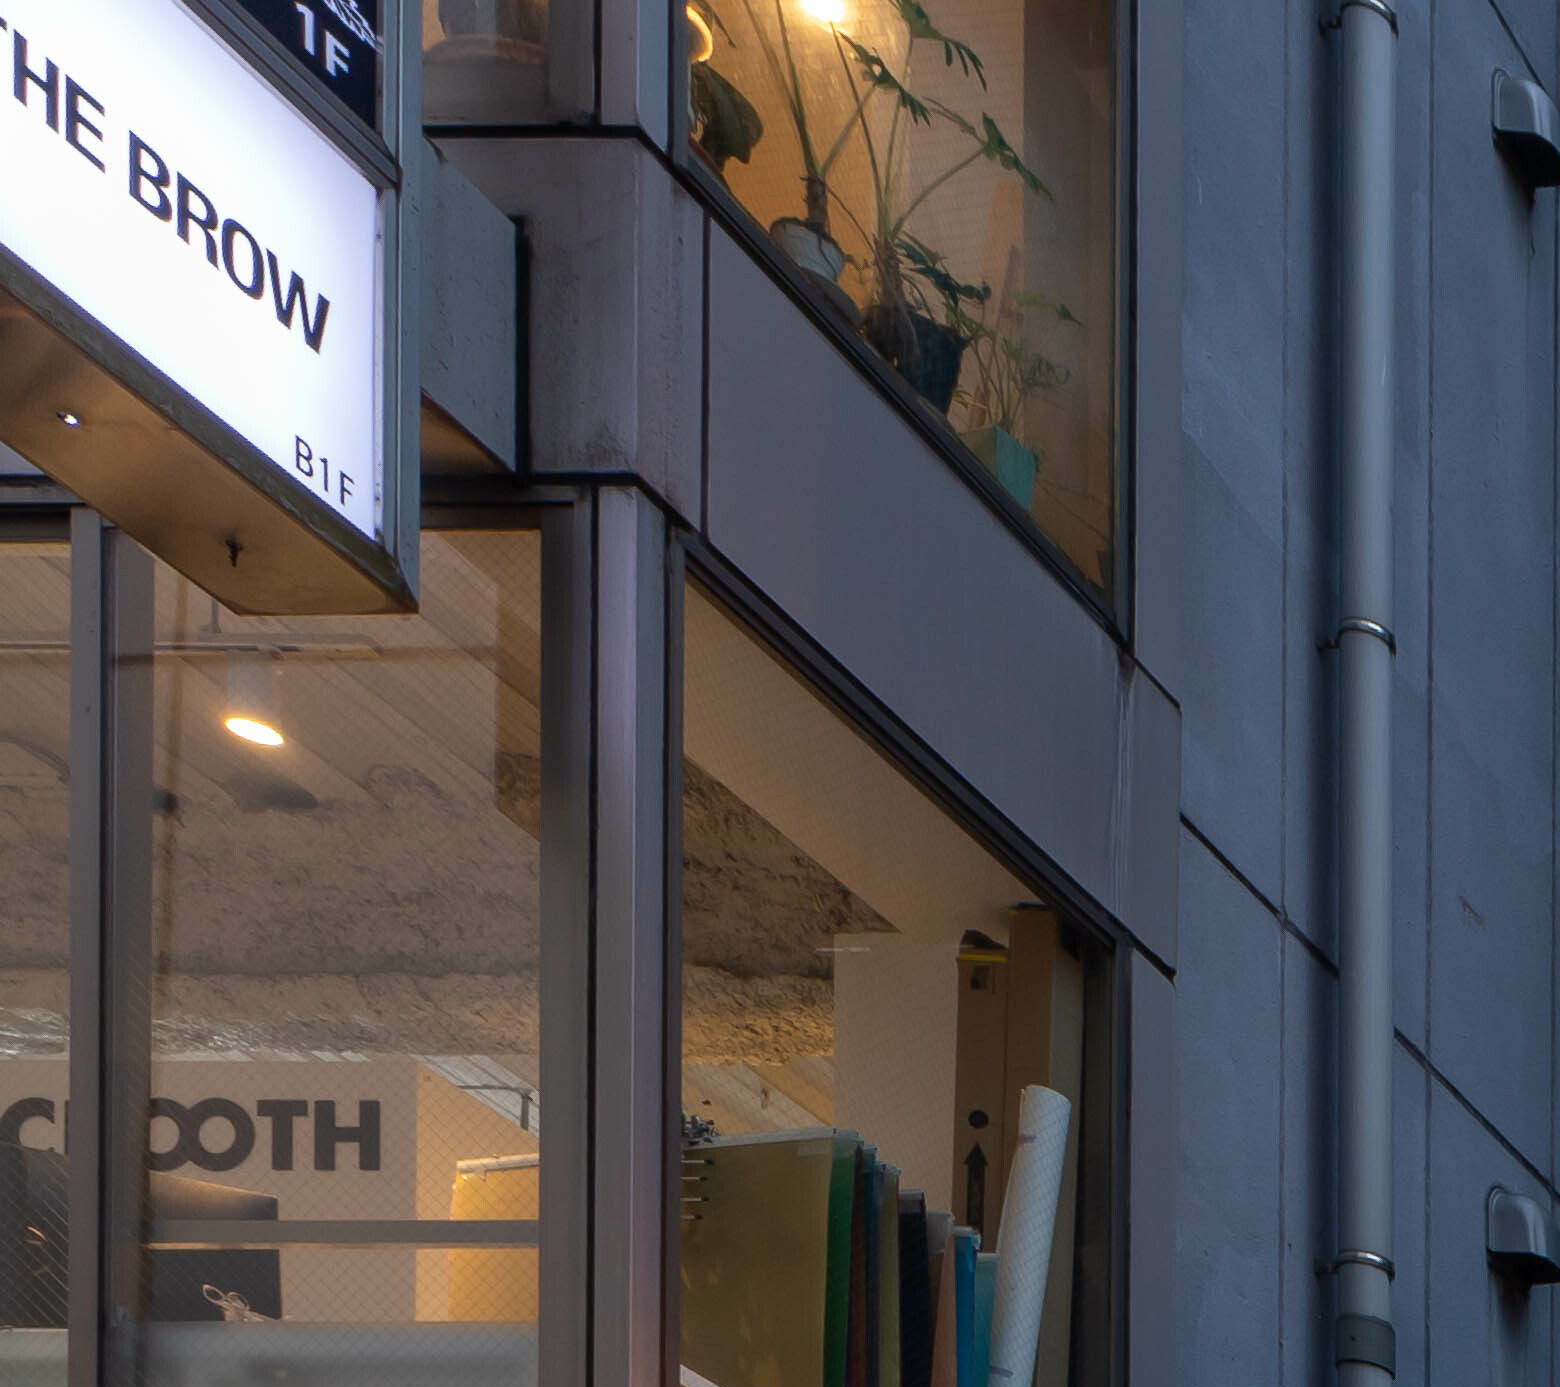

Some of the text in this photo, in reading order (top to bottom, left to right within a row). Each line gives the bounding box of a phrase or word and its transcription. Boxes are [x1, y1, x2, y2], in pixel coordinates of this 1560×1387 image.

[296, 2, 350, 77] 1F
[0, 16, 330, 354] HE BROW
[295, 434, 355, 506] B1F
